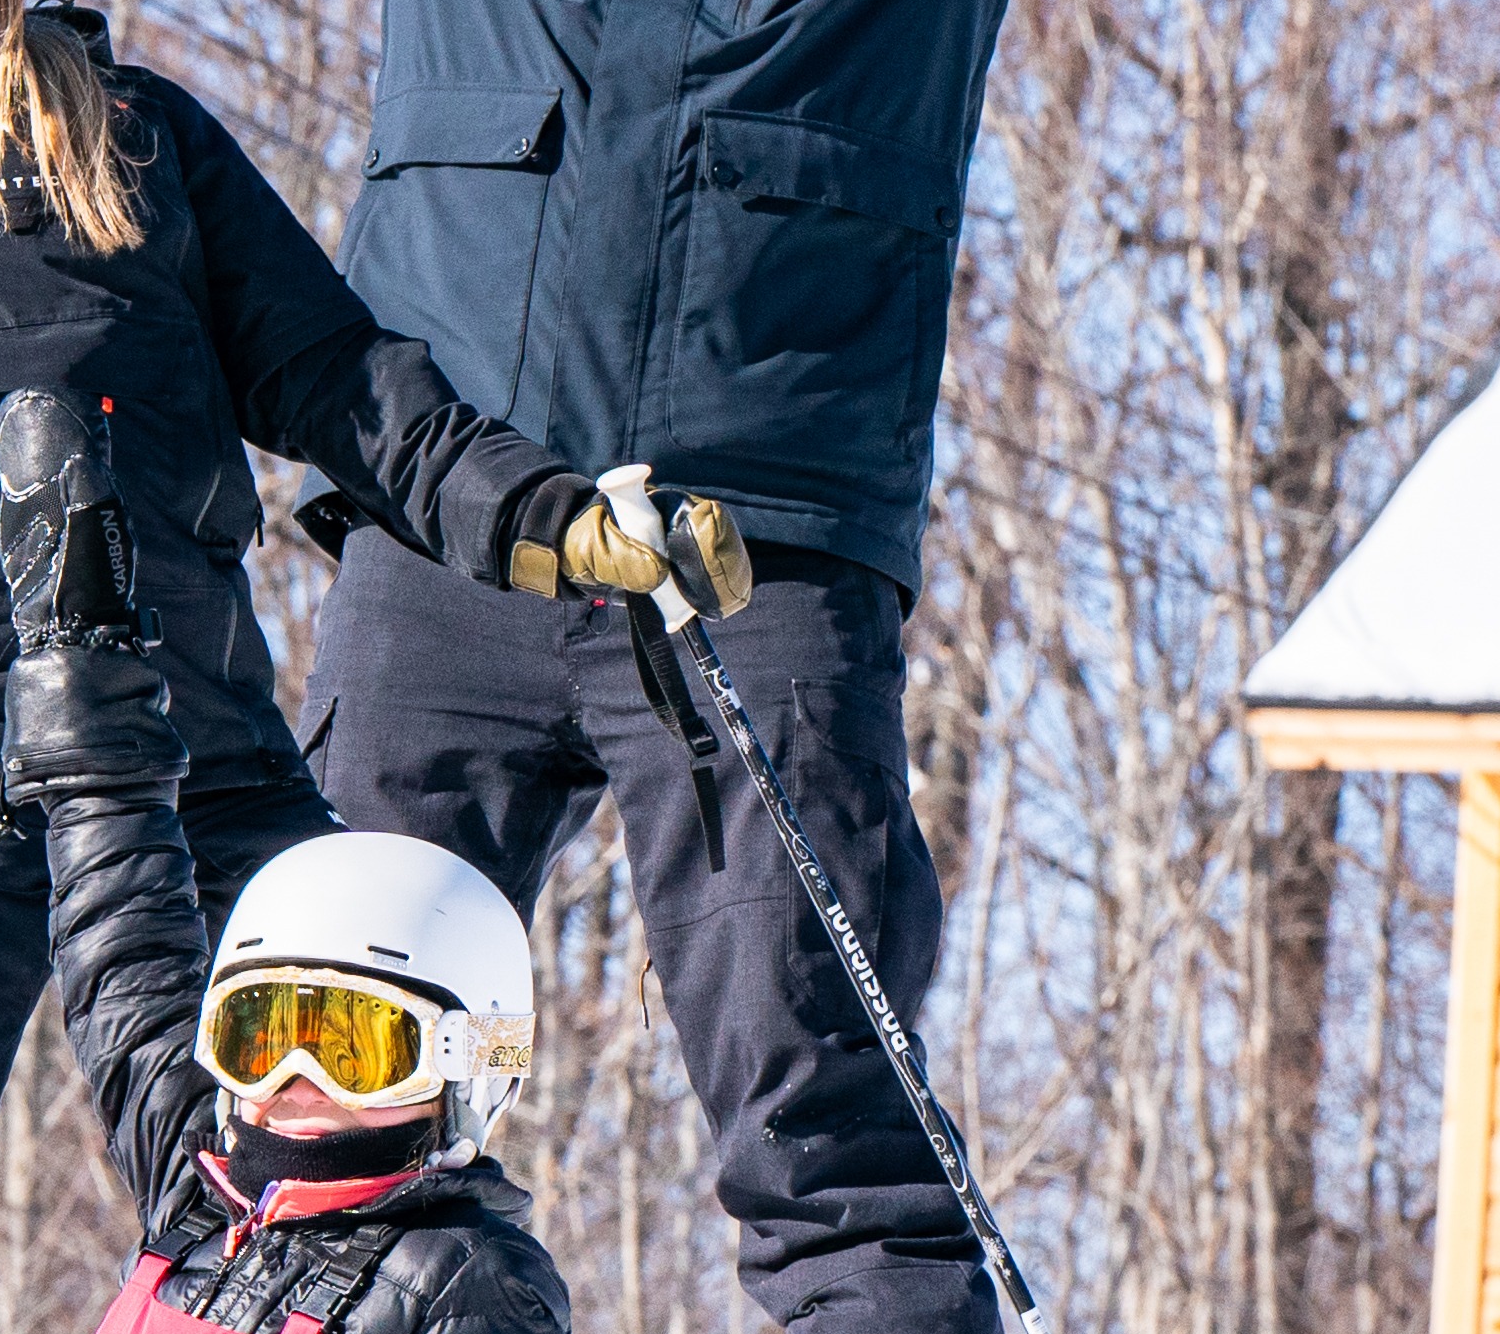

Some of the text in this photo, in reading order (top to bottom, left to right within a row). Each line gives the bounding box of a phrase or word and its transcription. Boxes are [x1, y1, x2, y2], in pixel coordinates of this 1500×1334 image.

[100, 510, 126, 595] KARBON
[826, 902, 909, 1053] ROSSIGNOL
[488, 1045, 532, 1067] ano
